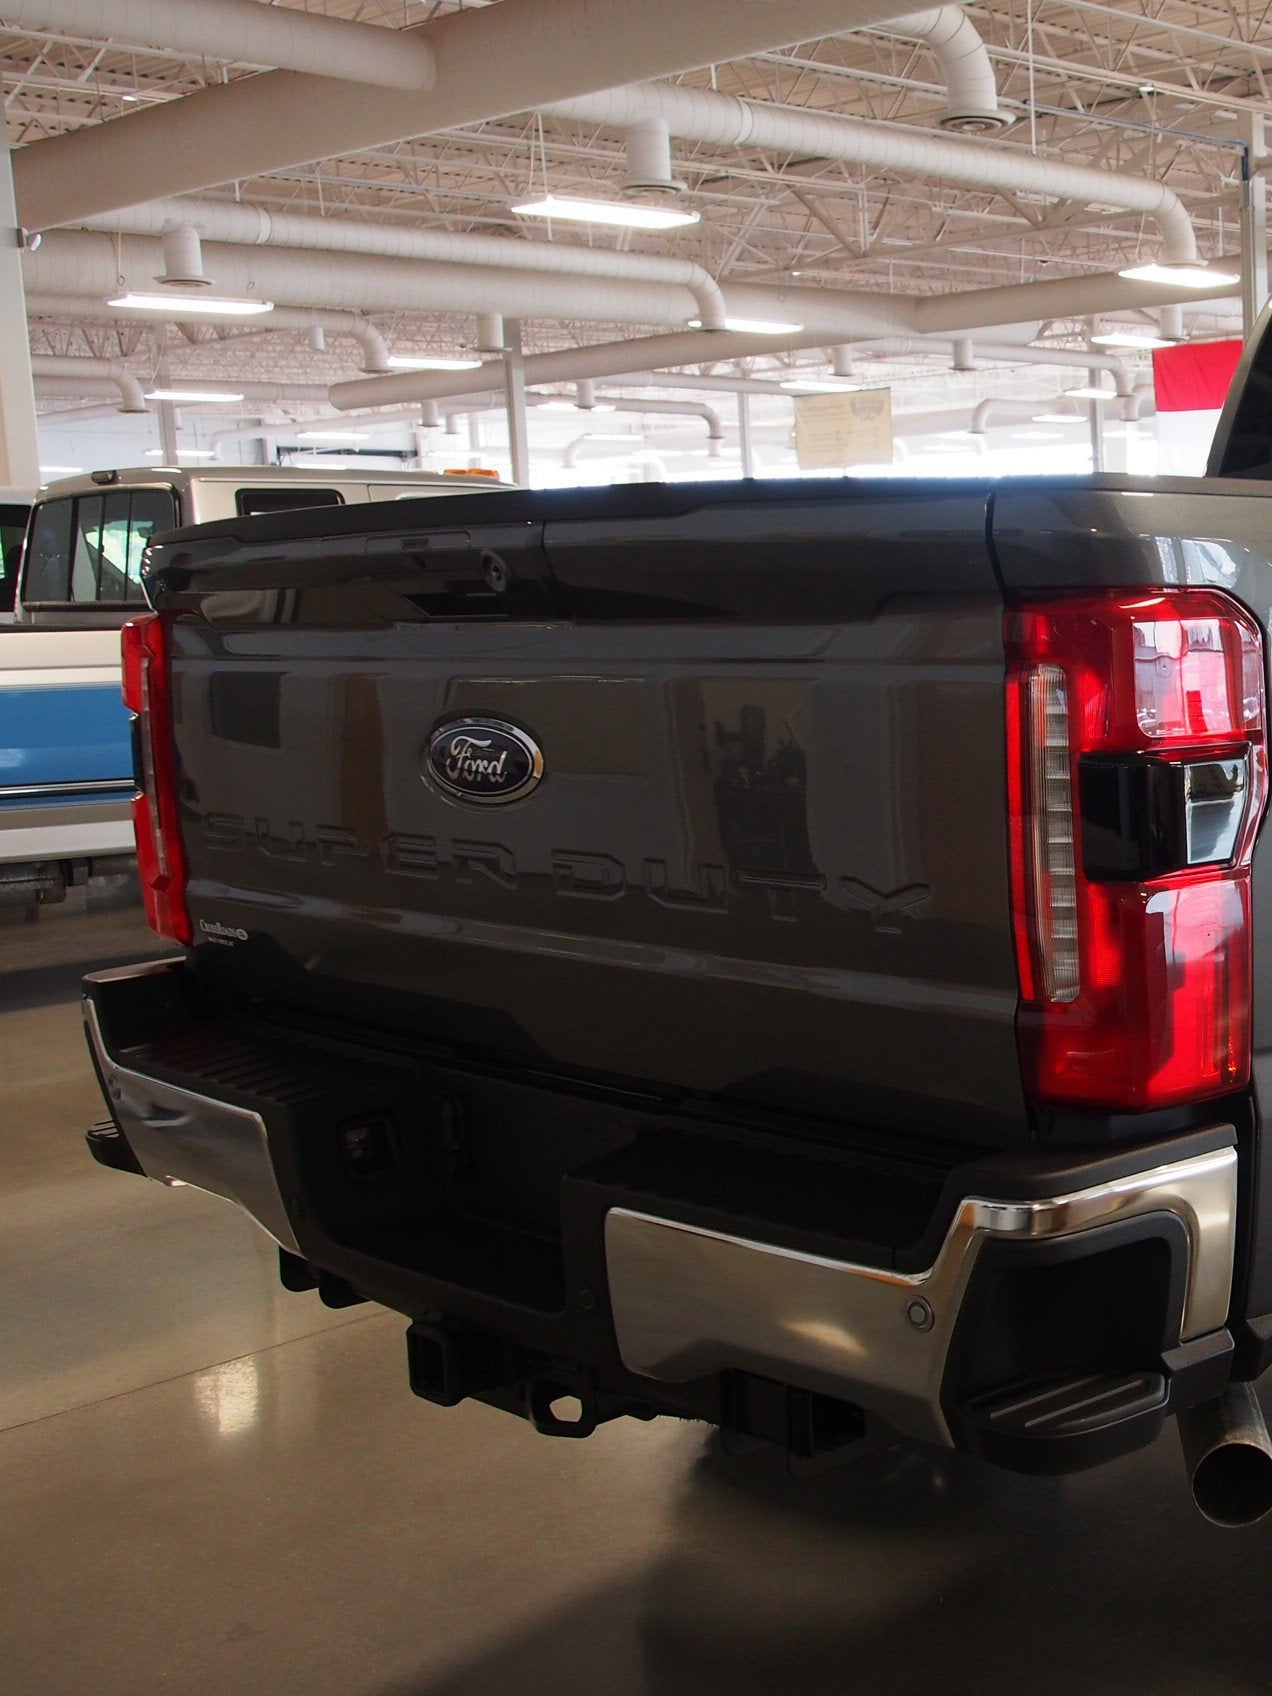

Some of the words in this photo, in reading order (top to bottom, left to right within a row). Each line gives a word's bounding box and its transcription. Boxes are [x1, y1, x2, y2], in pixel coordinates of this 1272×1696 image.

[446, 735, 508, 783] Ford
[201, 811, 518, 889] SUPER
[552, 848, 933, 934] DUTY
